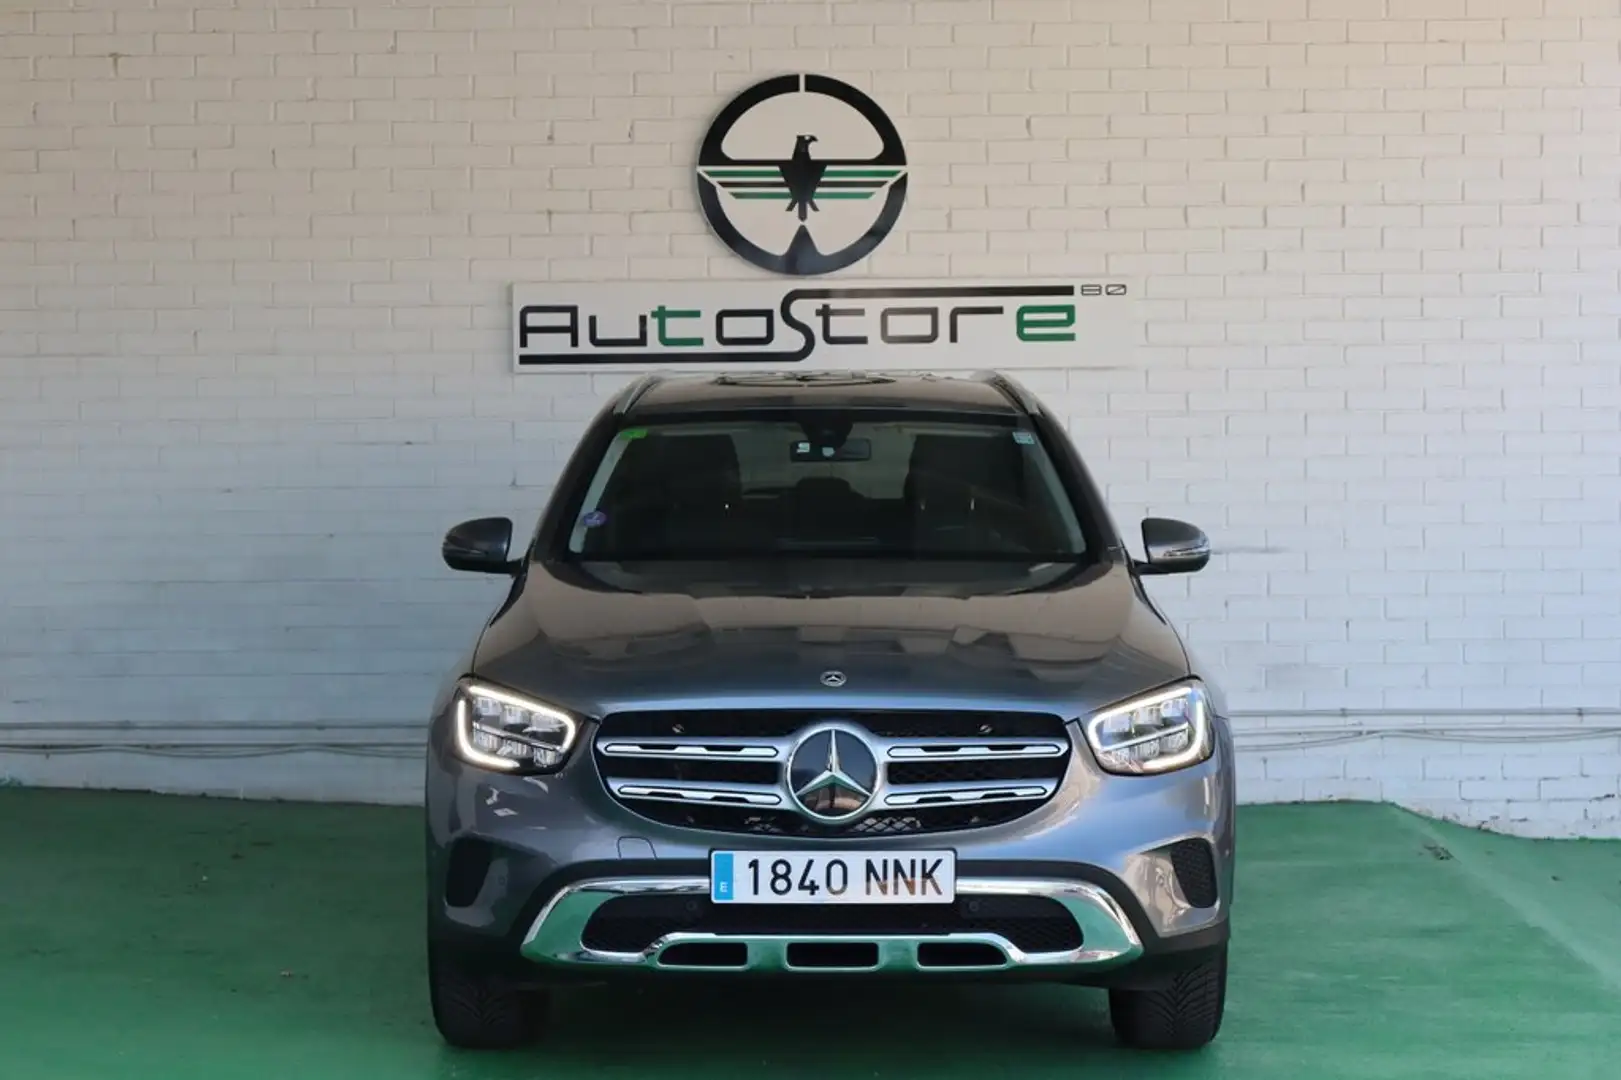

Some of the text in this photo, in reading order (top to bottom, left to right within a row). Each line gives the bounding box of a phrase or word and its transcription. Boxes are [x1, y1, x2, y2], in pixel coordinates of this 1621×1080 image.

[519, 285, 1076, 365] AutoStore
[719, 881, 729, 893] E
[748, 858, 943, 896] 1840 NNK
